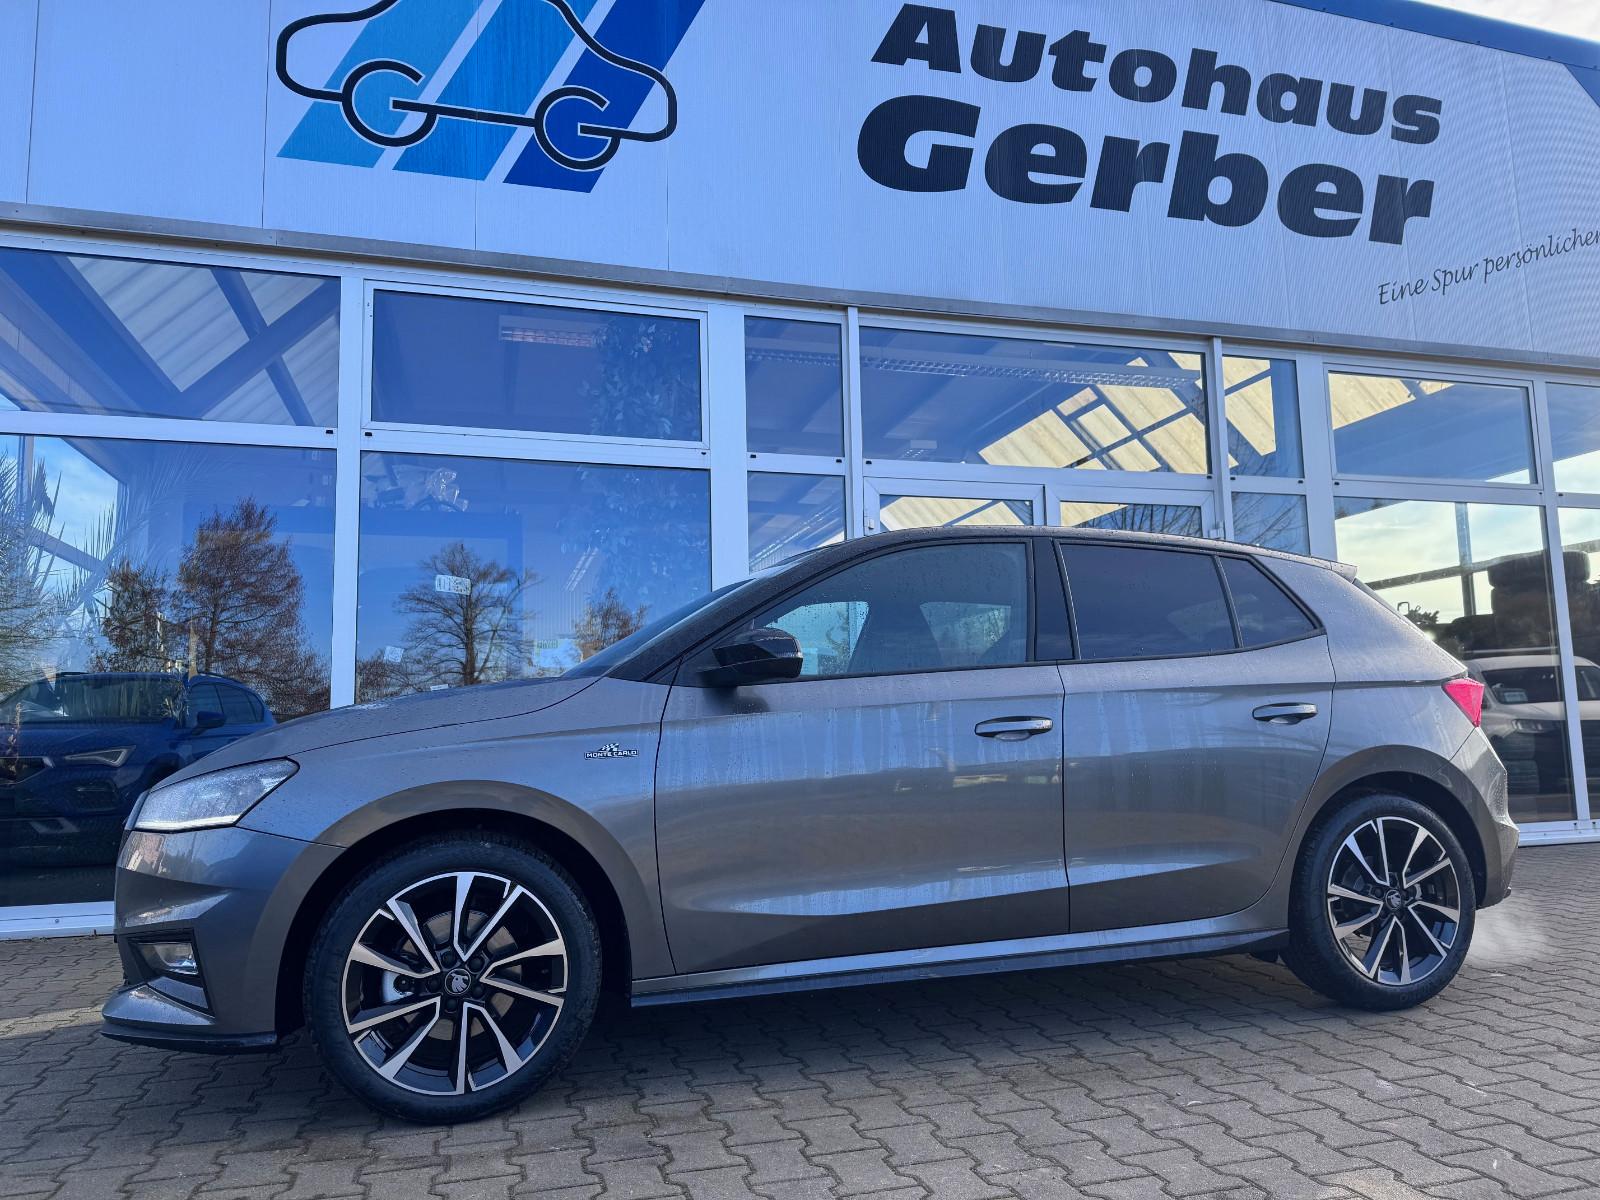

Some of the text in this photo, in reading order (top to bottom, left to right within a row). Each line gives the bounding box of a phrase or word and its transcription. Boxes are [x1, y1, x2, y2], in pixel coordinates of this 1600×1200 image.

[870, 4, 1443, 145] Autohaus
[857, 95, 1435, 245] Gerber
[1378, 278, 1429, 305] Eine
[1431, 263, 1479, 296] Spur
